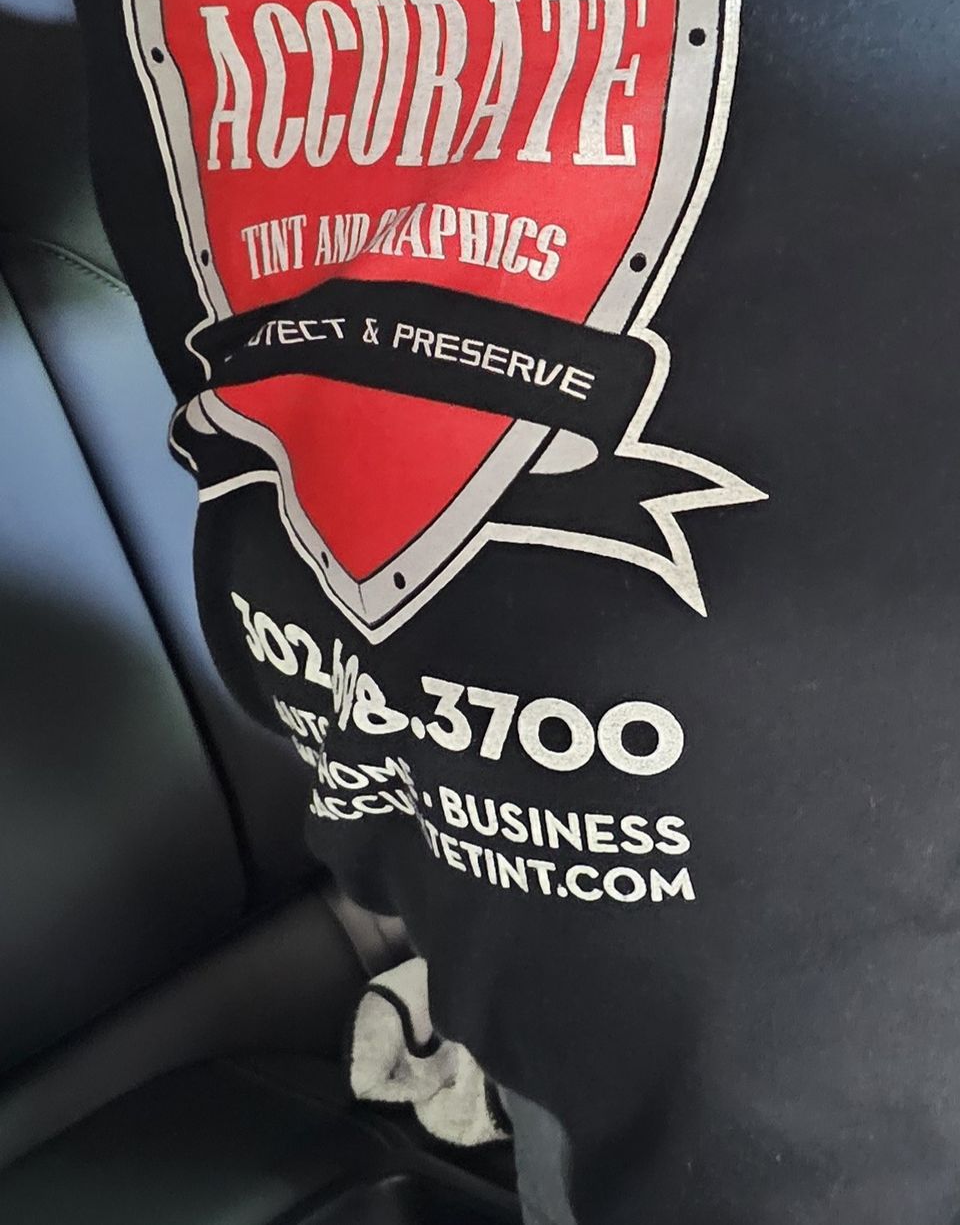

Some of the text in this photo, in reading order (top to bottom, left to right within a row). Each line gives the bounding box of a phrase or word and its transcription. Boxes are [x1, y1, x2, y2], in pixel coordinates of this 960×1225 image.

[241, 214, 307, 279] TINT
[314, 213, 371, 266] AND
[392, 323, 596, 400] PRESERVE
[317, 751, 417, 791] HOM
[438, 785, 692, 856] BUSINESS
